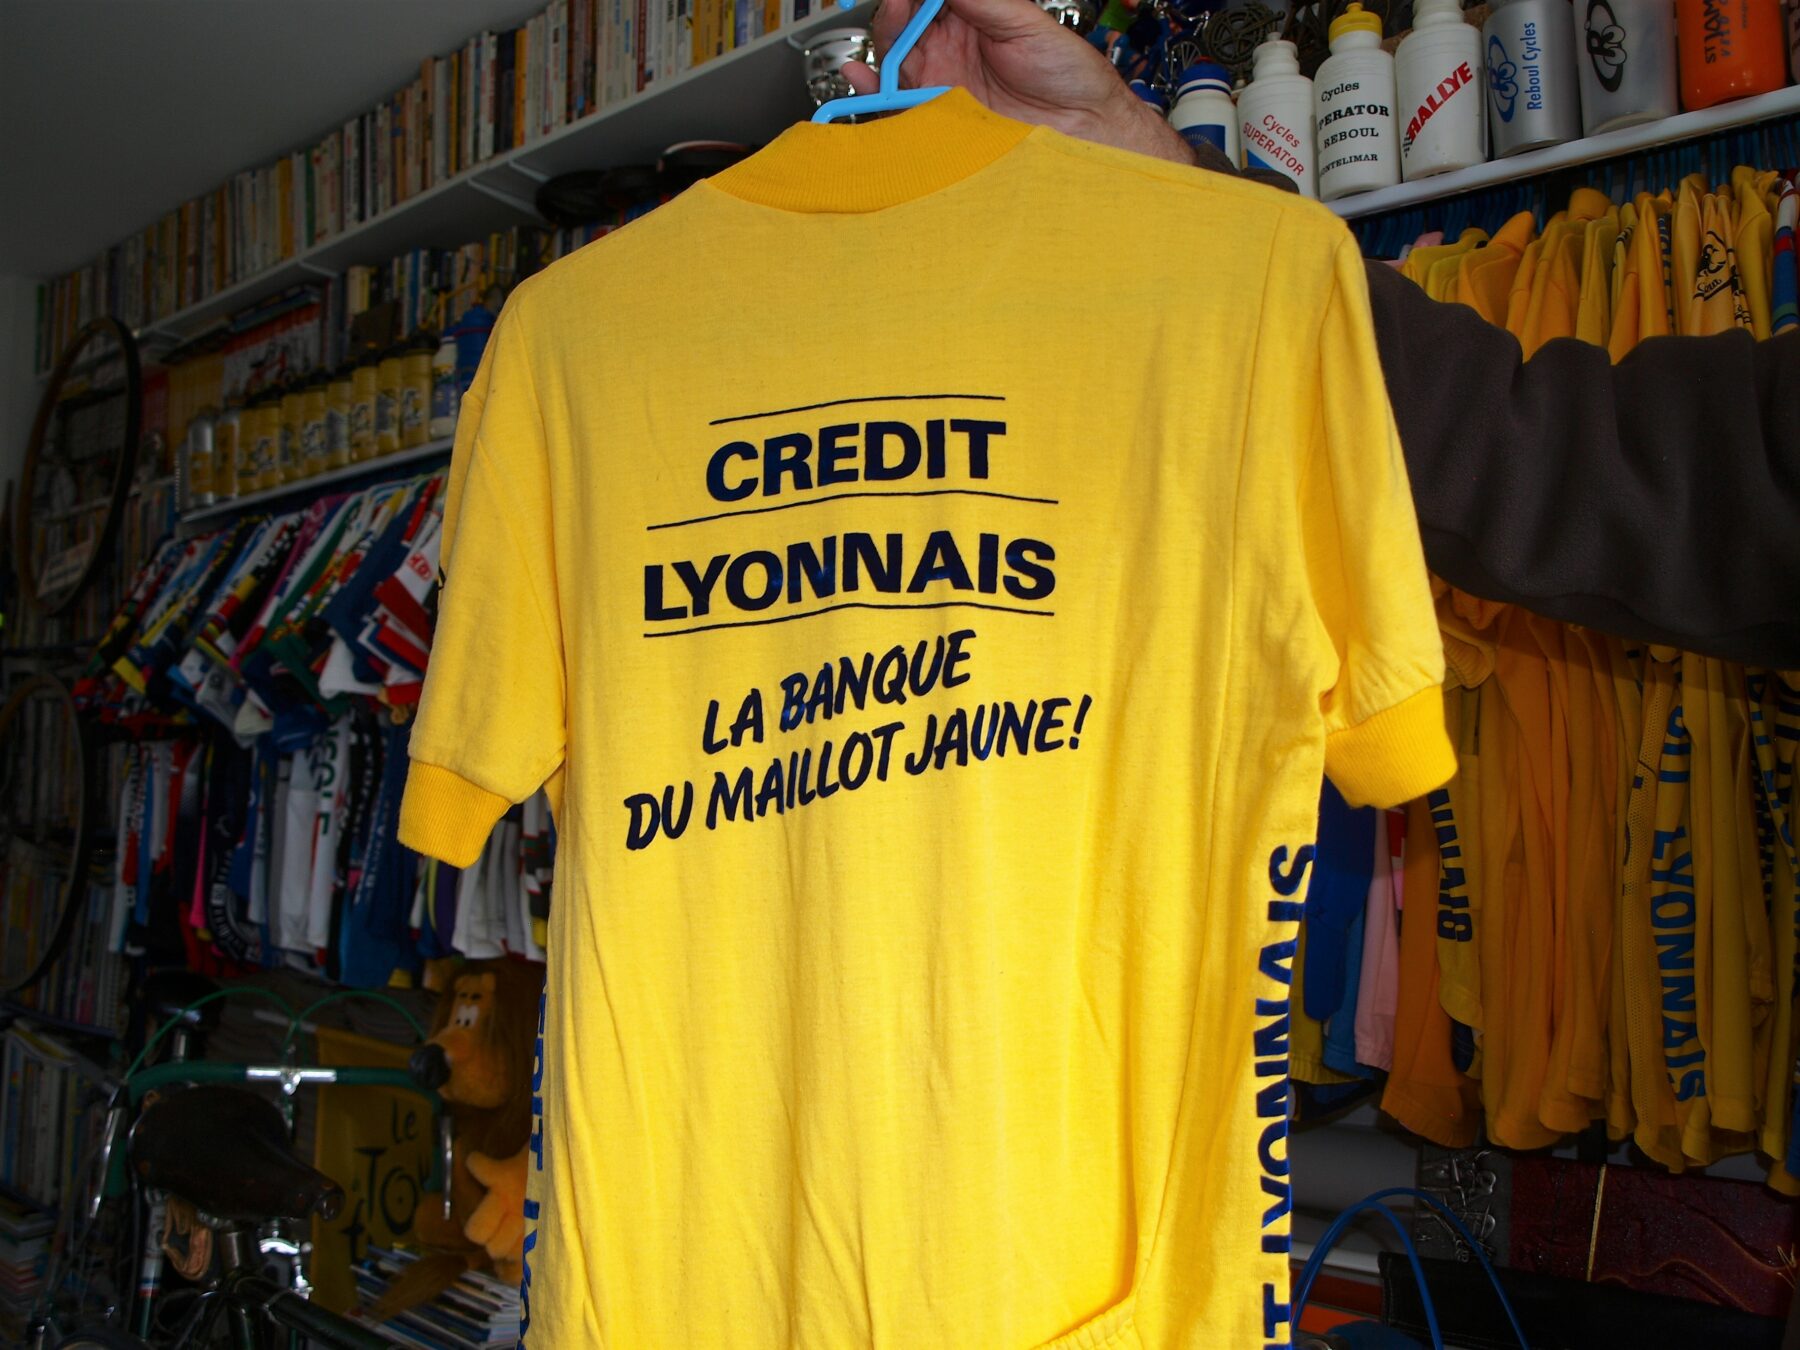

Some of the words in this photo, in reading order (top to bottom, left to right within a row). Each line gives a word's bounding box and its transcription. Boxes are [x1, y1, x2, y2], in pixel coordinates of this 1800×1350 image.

[1519, 22, 1542, 61] Cycles
[1321, 82, 1360, 103] Cycles
[1406, 61, 1473, 143] RALLYE
[1522, 65, 1543, 111] Reboul
[1263, 114, 1300, 148] Cycles
[1318, 104, 1390, 131] PERATOR
[1323, 127, 1379, 149] REBOUL
[1243, 122, 1305, 176] SUPERATOR
[1320, 153, 1378, 177] ONTELIMAR
[706, 419, 1006, 502] CREDIT
[644, 531, 1056, 621] LYONNAIS
[702, 688, 763, 754] LA
[779, 629, 977, 732] BANQUE
[624, 781, 693, 851] DU
[706, 722, 905, 830] MAILLOT
[905, 694, 1093, 776] JAUNE!
[1650, 825, 1707, 1102] LYONNAIS
